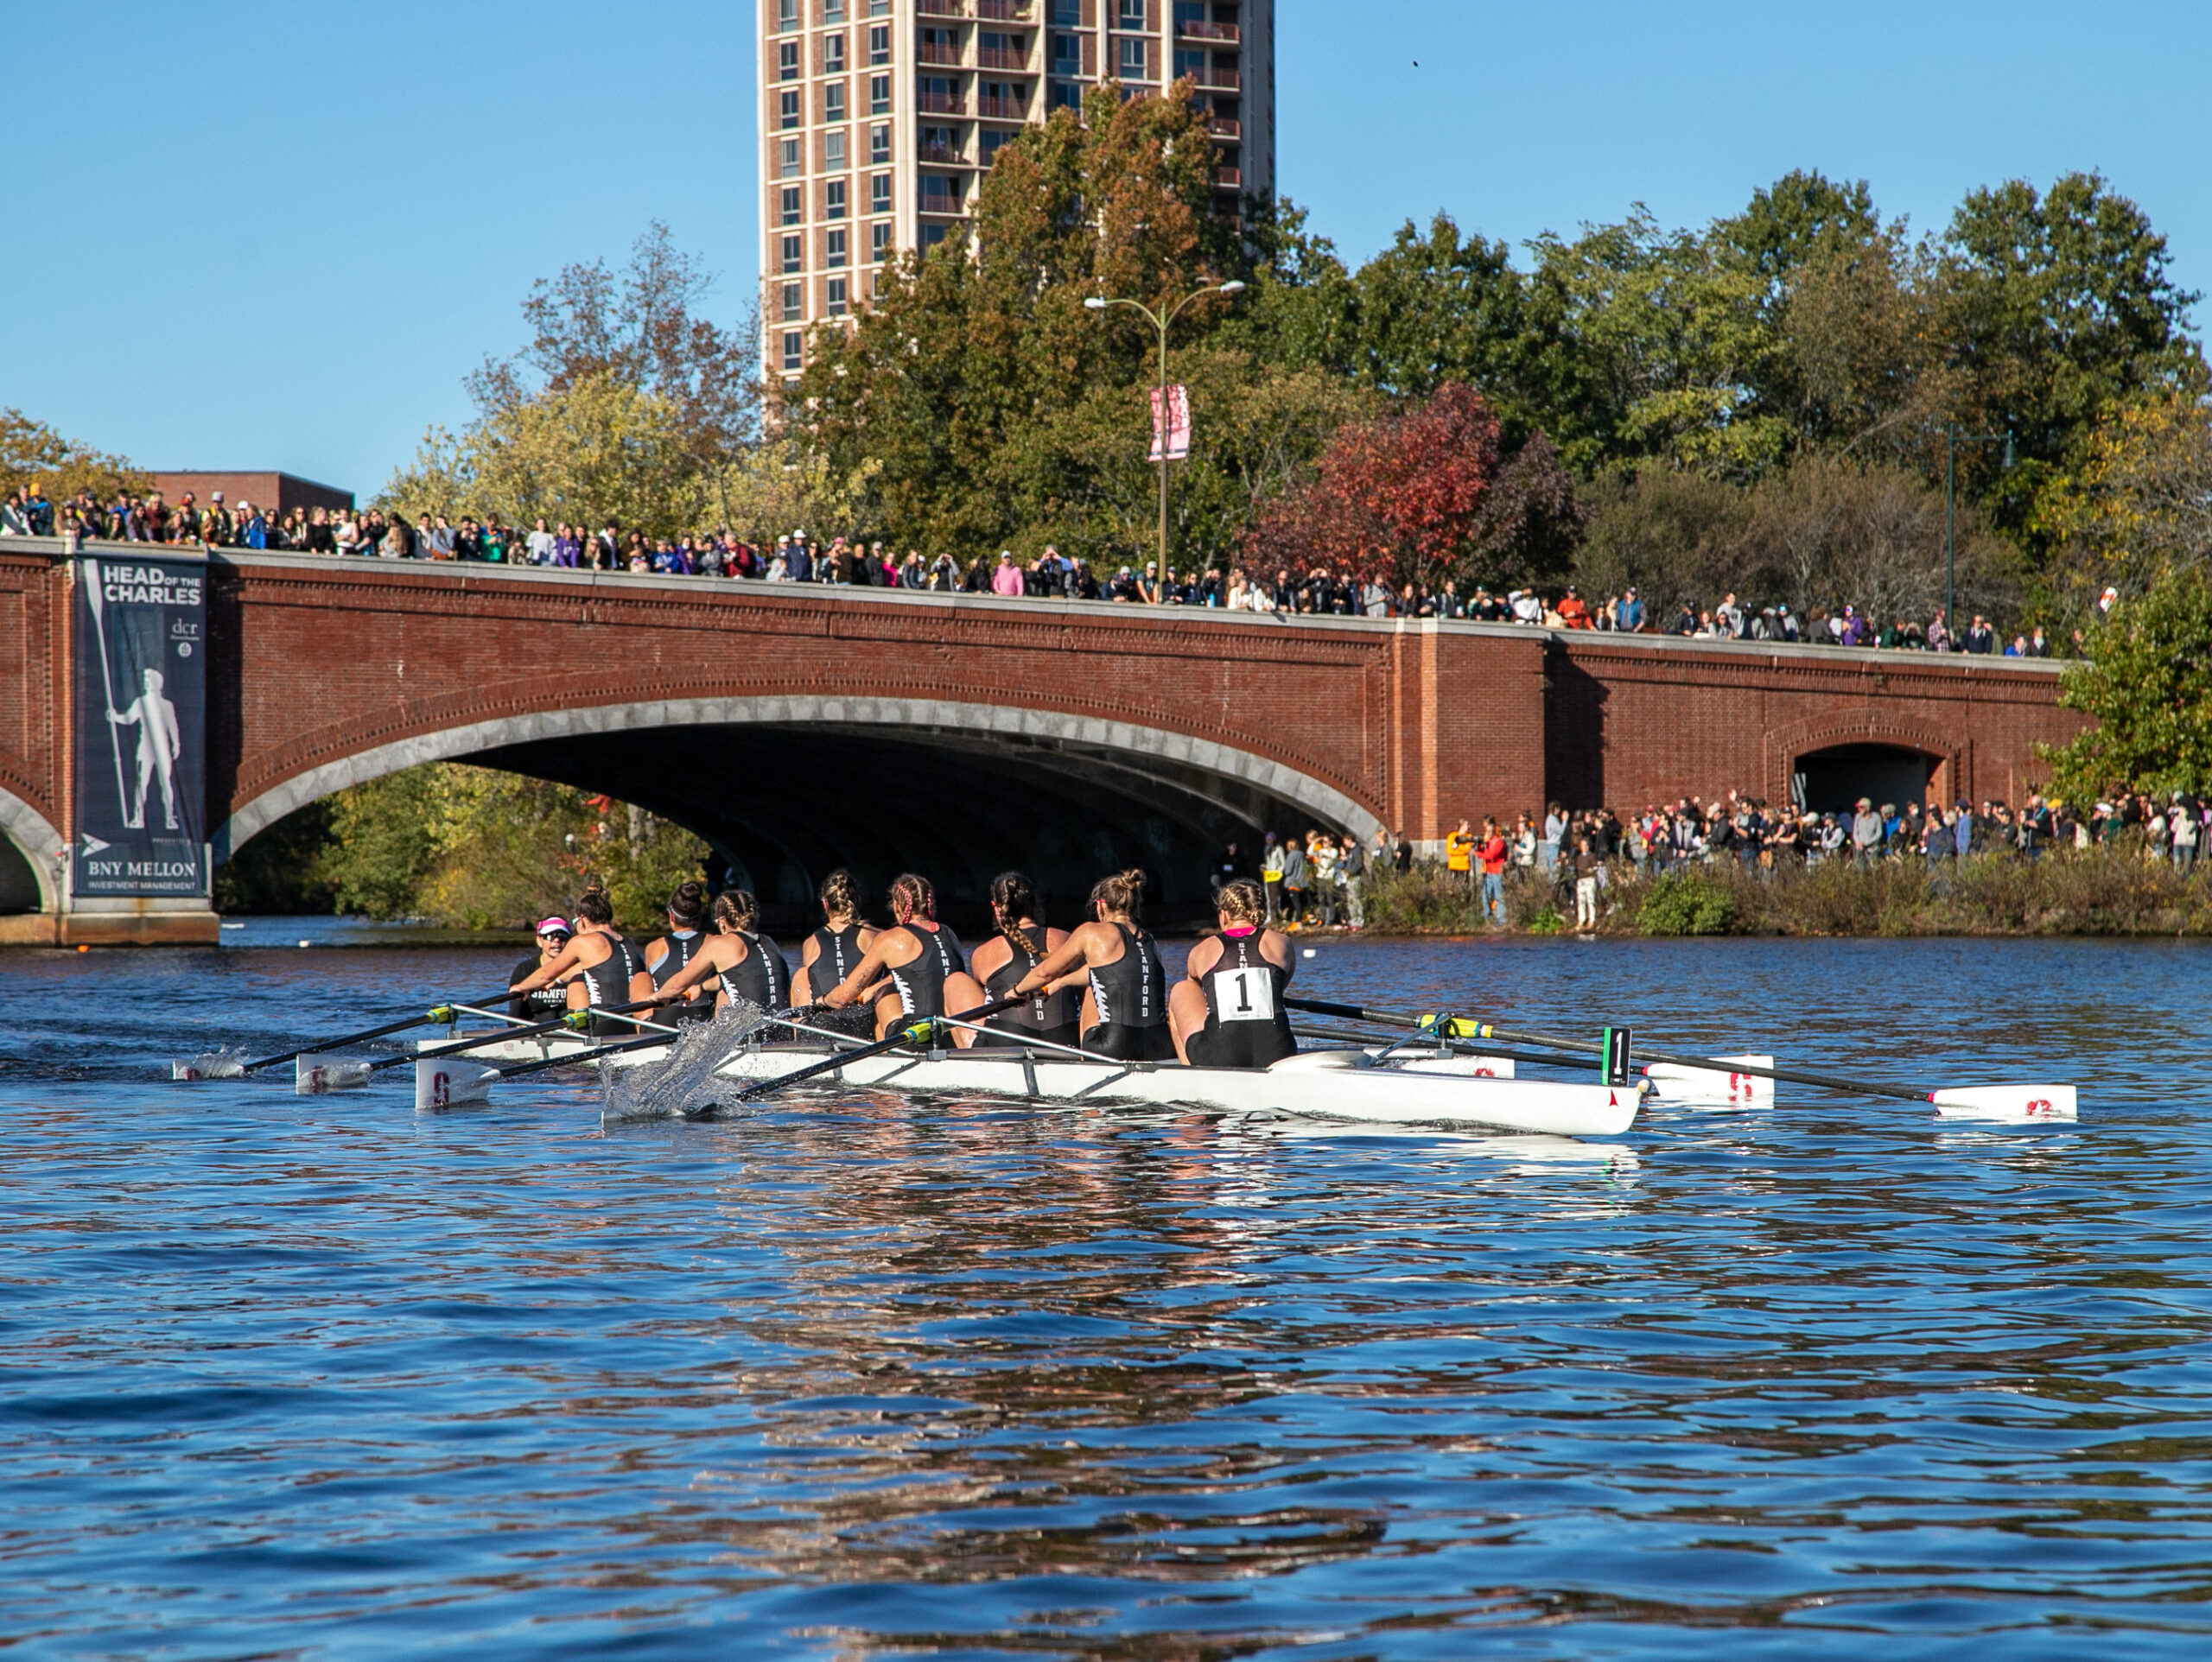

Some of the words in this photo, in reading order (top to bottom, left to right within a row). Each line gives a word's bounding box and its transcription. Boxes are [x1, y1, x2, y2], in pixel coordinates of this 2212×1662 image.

[104, 565, 164, 585] HEAD
[164, 577, 179, 586] OF
[181, 578, 200, 587] THE
[105, 584, 201, 606] CHARLES
[172, 618, 198, 634] dcr
[88, 861, 122, 876] BNY
[127, 861, 196, 877] MELLON
[140, 882, 196, 891] MANAGEMENT
[620, 943, 634, 983] STANFO
[835, 936, 846, 985] STANFO
[933, 935, 950, 977] STANF
[1238, 942, 1249, 968] STAN
[756, 942, 777, 1005] STANFORD
[1136, 942, 1149, 1018] STANFORD
[531, 988, 567, 999] STANFO
[1235, 973, 1253, 1012] 1
[1614, 1031, 1624, 1075] 1
